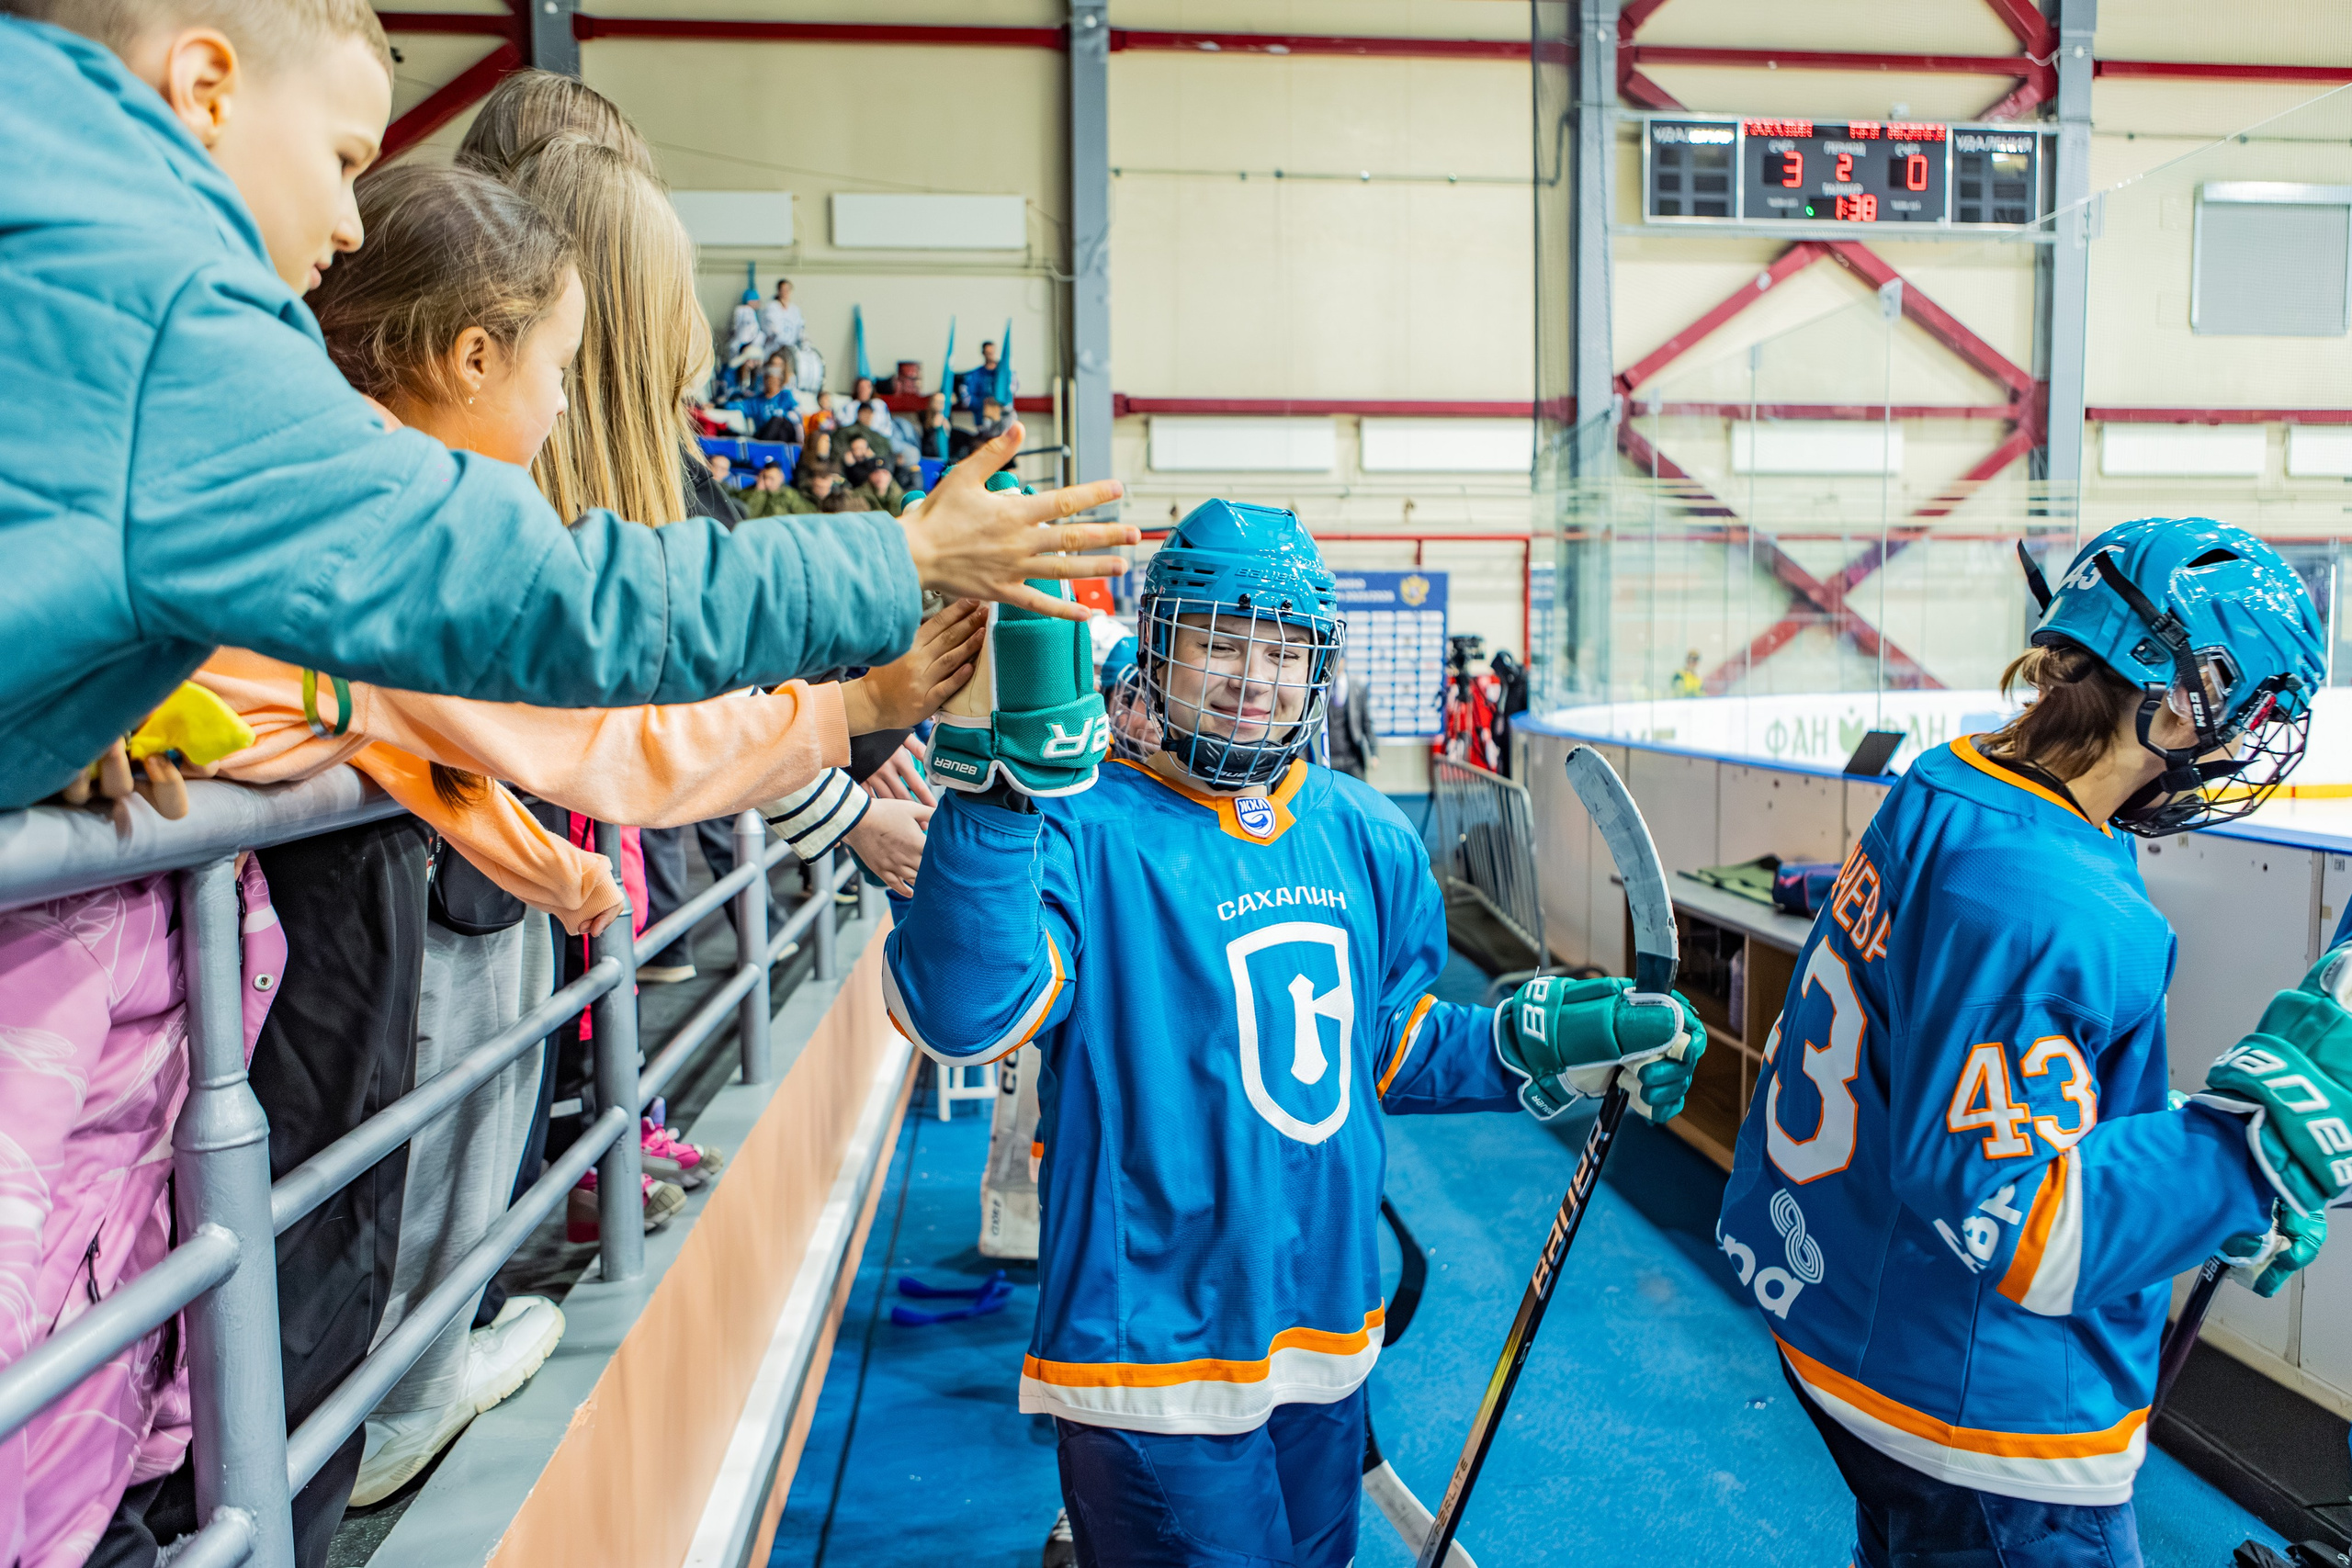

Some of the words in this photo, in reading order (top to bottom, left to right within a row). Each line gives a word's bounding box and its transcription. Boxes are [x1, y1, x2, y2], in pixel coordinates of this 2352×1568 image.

[1782, 151, 1804, 188] 3
[1836, 152, 1853, 182] 2
[1906, 153, 1928, 191] 0
[1836, 194, 1878, 222] 1:38
[2188, 691, 2207, 728] CCM
[1765, 715, 1828, 760] ФАН
[933, 756, 978, 776] BAUER
[1238, 798, 1269, 814] ЖХЛ
[1216, 886, 1347, 921] САХАЛИН
[1946, 1034, 2098, 1160] 43
